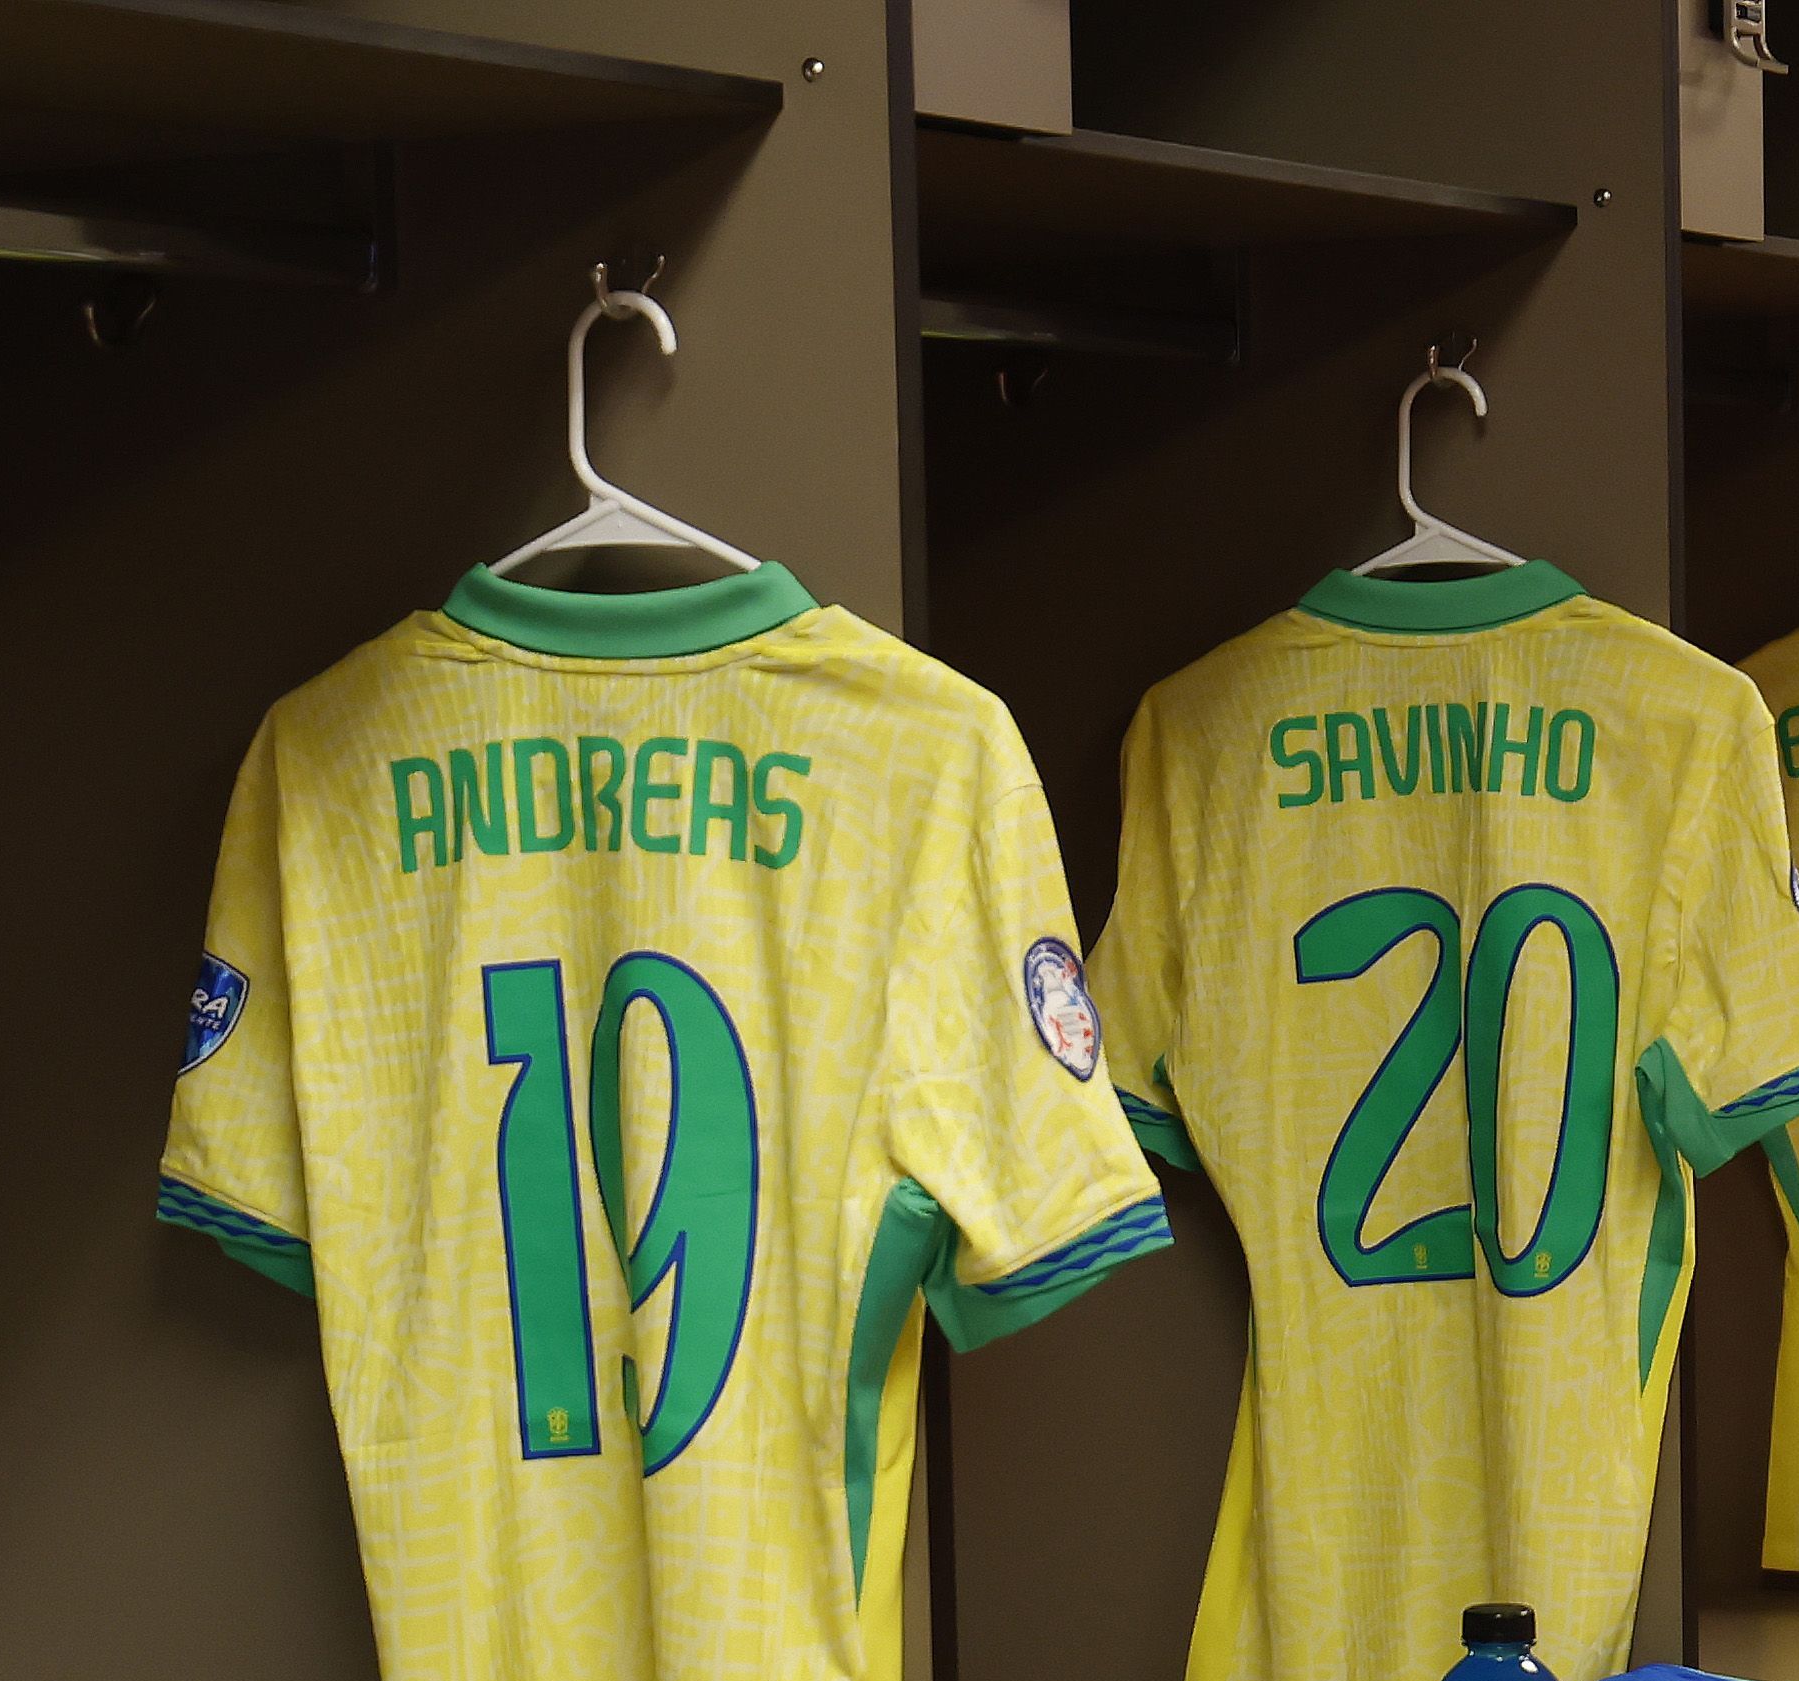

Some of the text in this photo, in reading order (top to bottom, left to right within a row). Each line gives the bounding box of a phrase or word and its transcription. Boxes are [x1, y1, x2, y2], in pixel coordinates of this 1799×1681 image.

[390, 736, 811, 873] ANDREAS
[1270, 702, 1596, 809] SAVINHO
[481, 951, 761, 1478] 19
[1293, 882, 1621, 1298] 20
